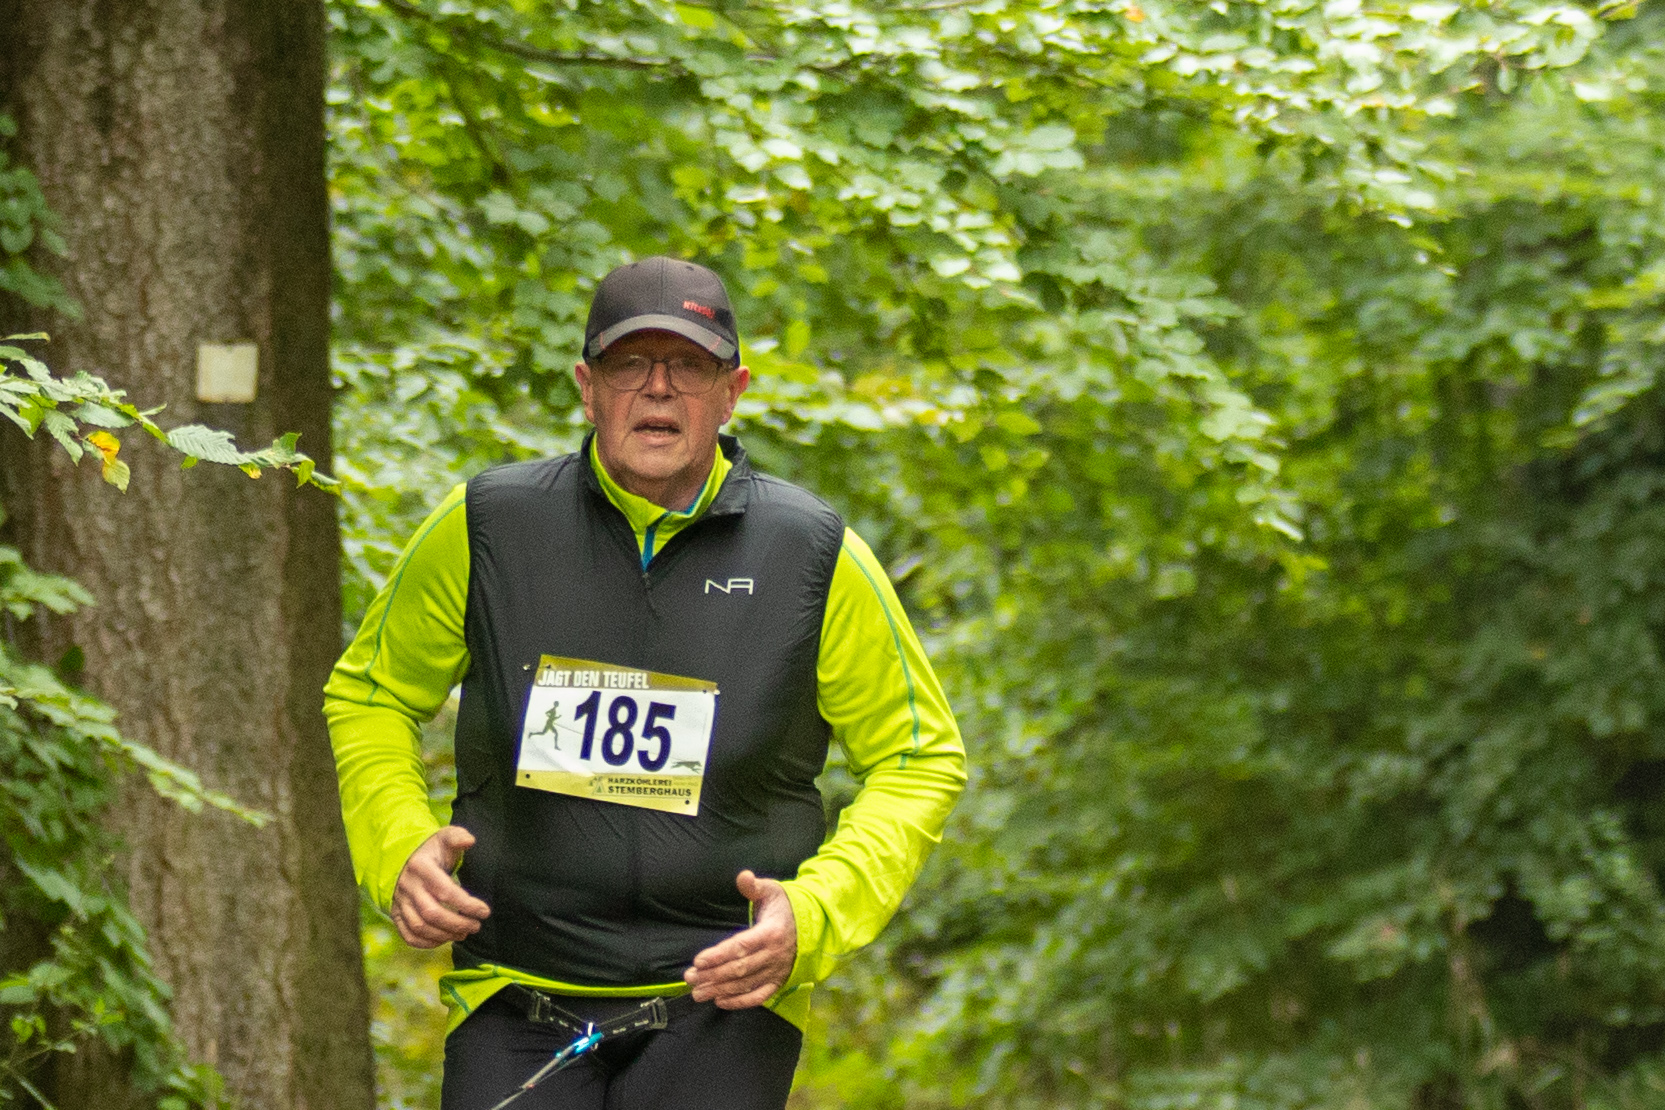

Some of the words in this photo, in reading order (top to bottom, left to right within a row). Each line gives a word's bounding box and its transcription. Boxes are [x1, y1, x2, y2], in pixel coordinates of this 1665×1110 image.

[538, 671, 571, 687] JAGT
[573, 672, 600, 687] DEN
[603, 672, 649, 689] TEUFEL
[574, 690, 677, 772] 185
[608, 786, 692, 797] STEMBERGHAUS
